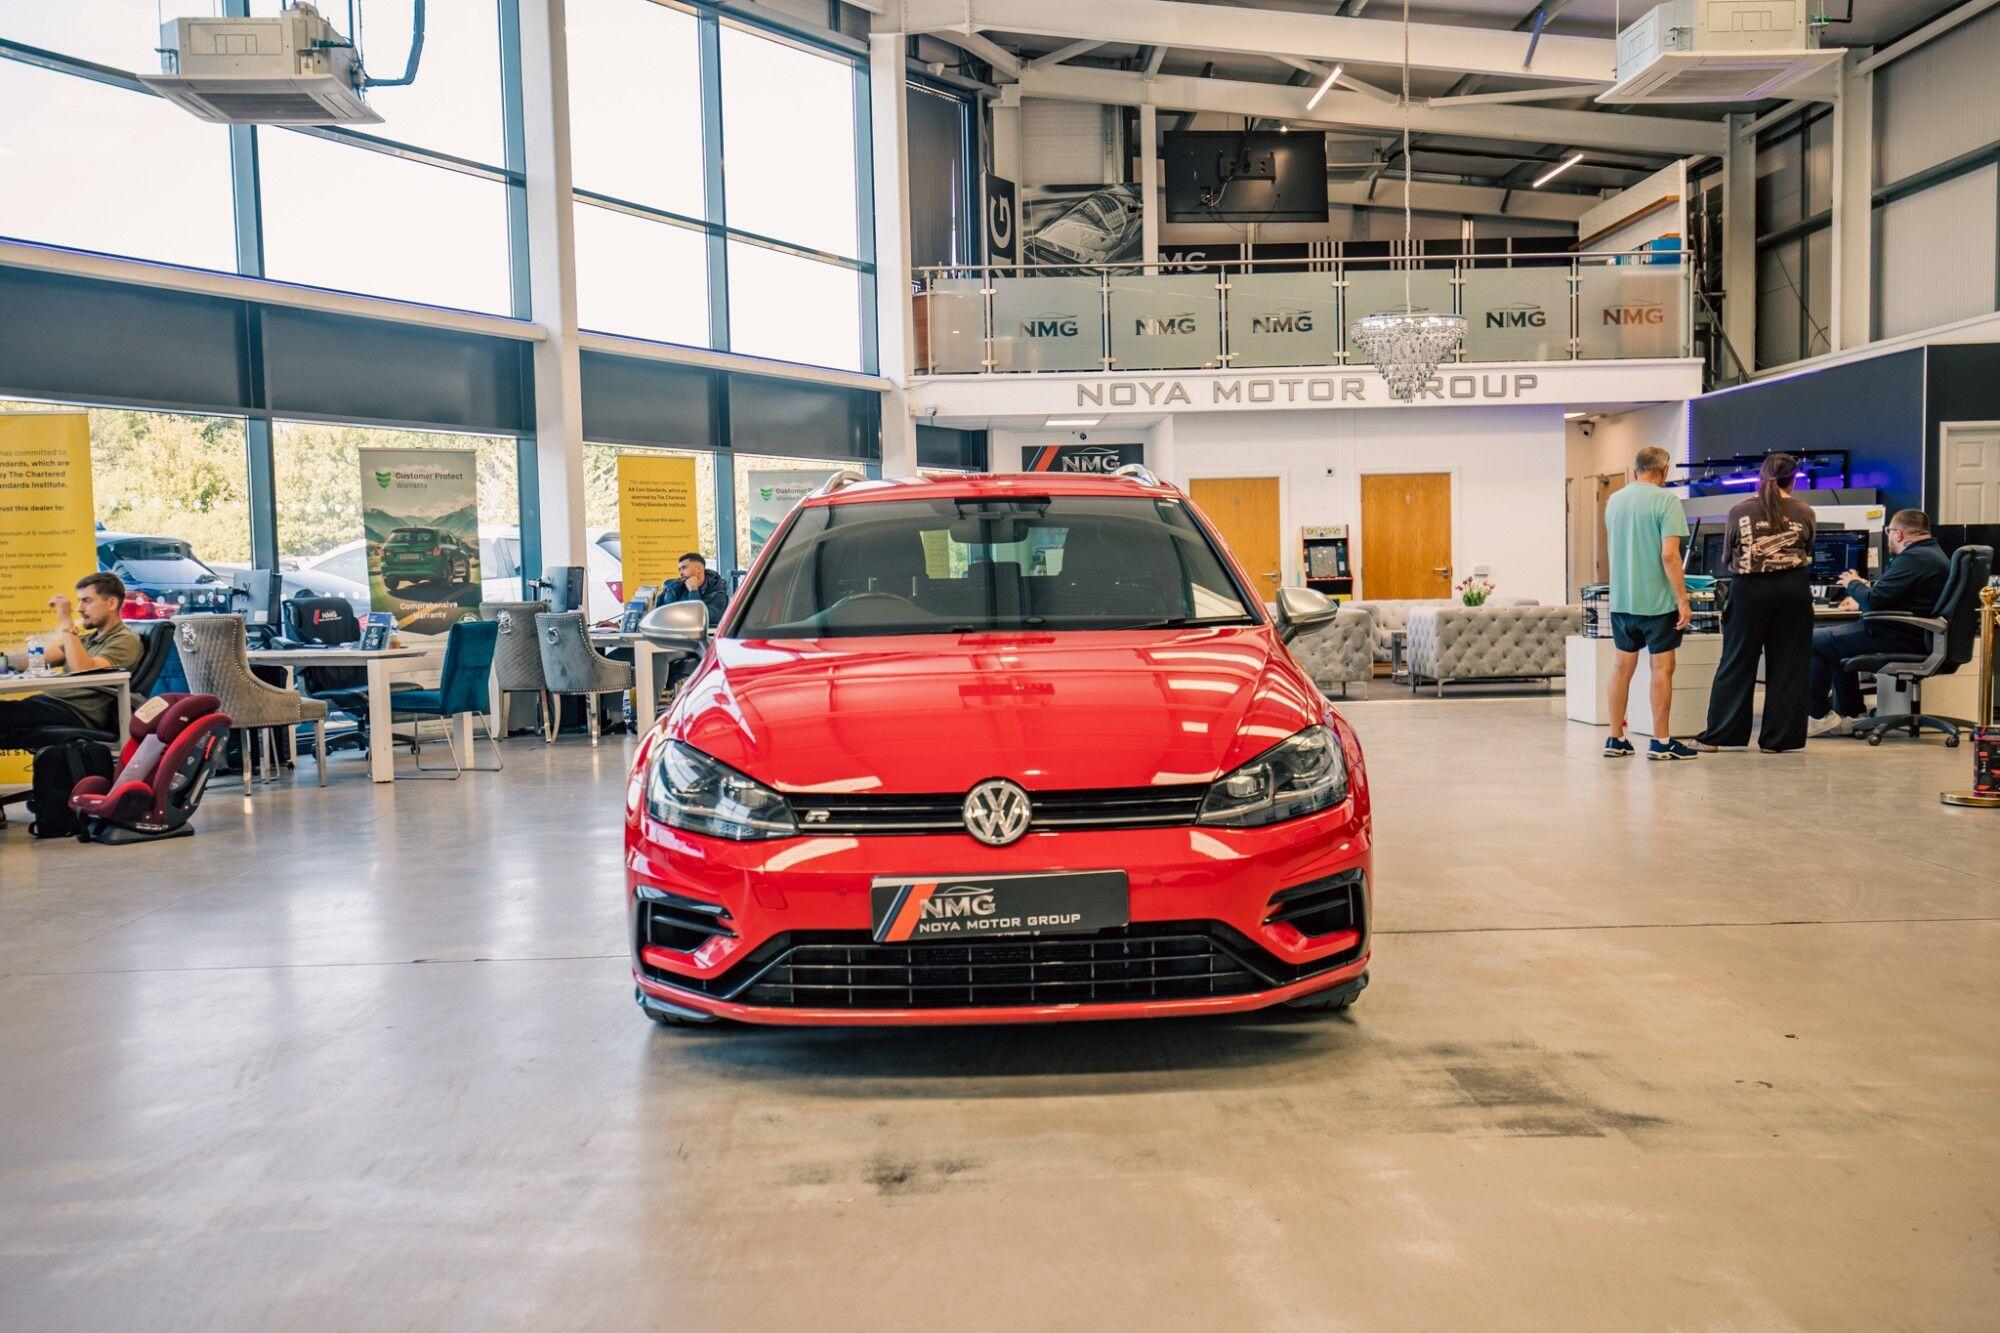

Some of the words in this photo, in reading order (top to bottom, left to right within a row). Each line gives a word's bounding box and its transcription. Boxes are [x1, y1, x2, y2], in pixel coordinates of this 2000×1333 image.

[1252, 316, 1313, 334] NMG
[1486, 311, 1547, 328] NMG
[1603, 308, 1663, 325] NMG
[1019, 320, 1078, 337] NMG
[1135, 318, 1196, 336] NMG
[1077, 381, 1191, 406] NOYA
[1213, 378, 1366, 403] MOTOR
[1062, 454, 1120, 472] NMG
[400, 601, 458, 611] Comprehensive
[920, 894, 996, 919] NMG
[919, 922, 961, 933] NOYA
[967, 917, 1021, 930] MOTOR
[1027, 913, 1081, 926] GROUP
